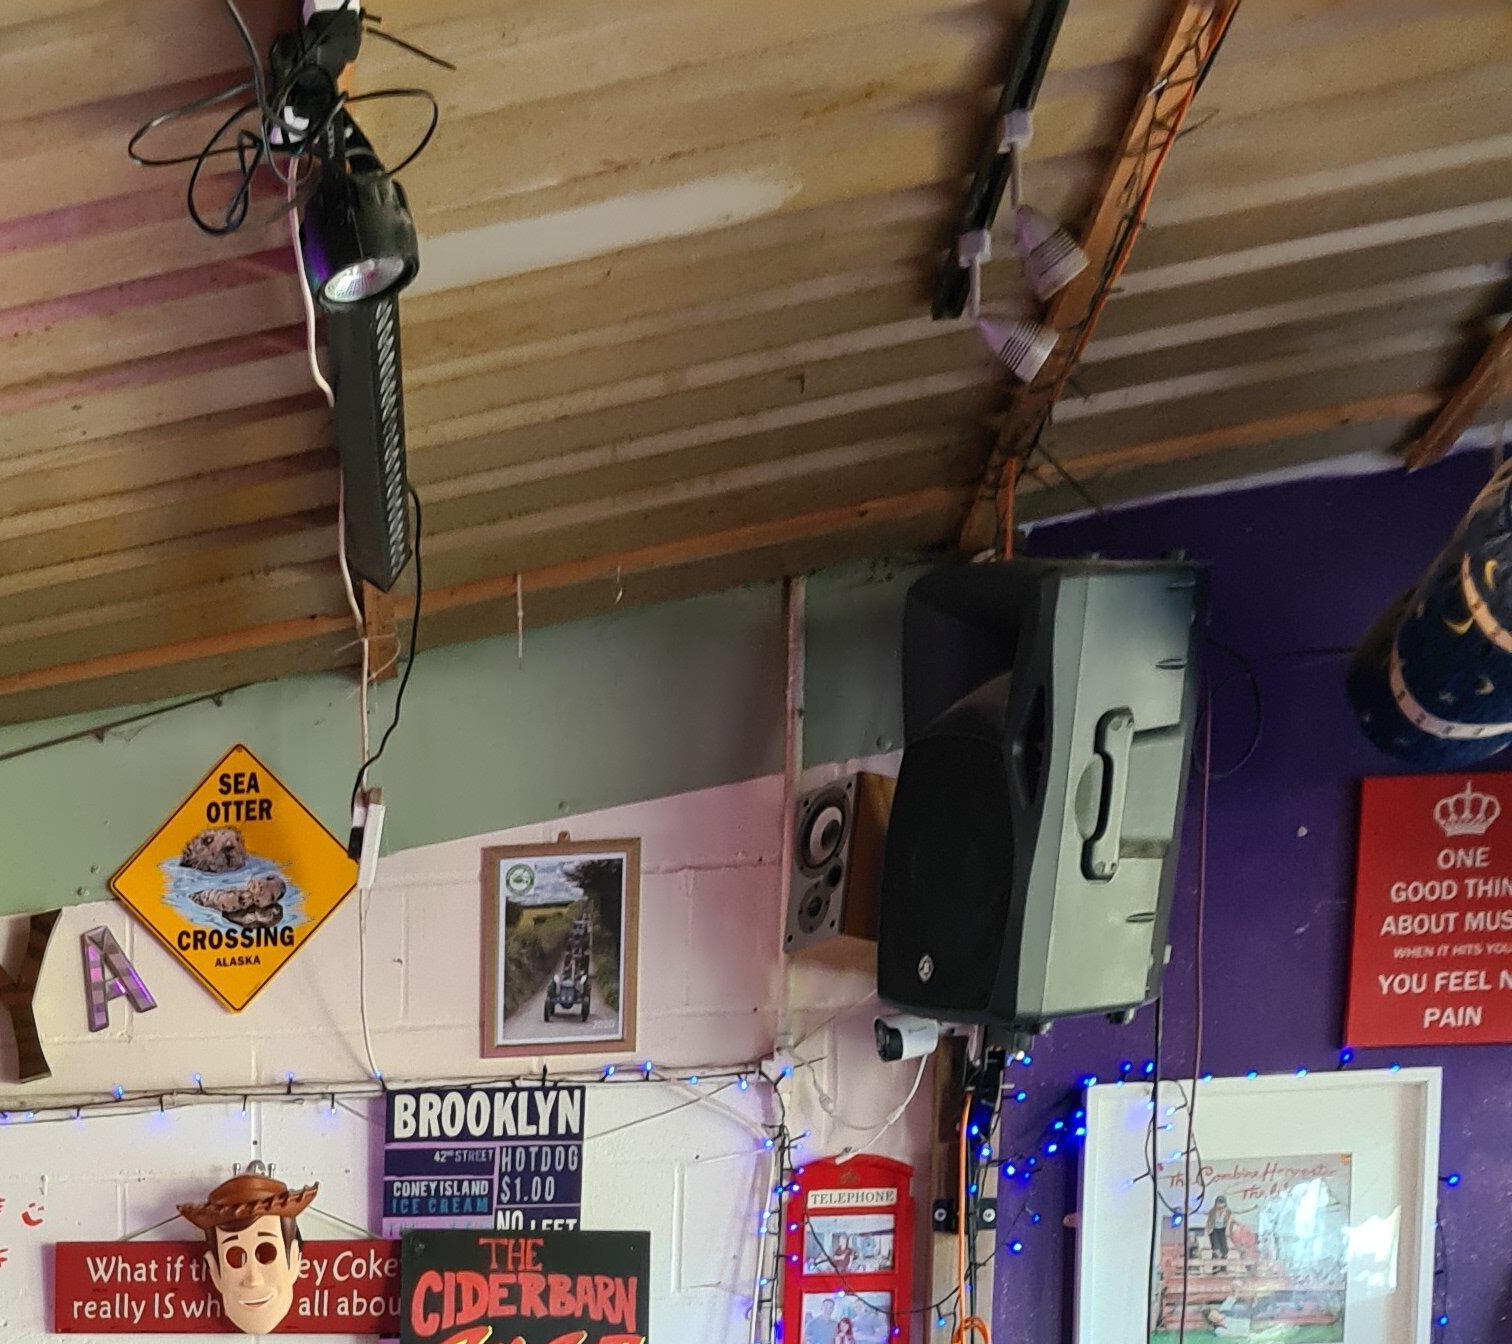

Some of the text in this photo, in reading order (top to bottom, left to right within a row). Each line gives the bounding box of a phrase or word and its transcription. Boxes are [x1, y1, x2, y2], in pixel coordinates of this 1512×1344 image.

[217, 771, 260, 796] SEA
[205, 798, 273, 824] OTTER
[1437, 846, 1491, 870] ONE
[1390, 880, 1458, 903] GOOD
[1380, 912, 1460, 938] ABOUT
[176, 925, 295, 952] CROSSING
[214, 954, 262, 968] ALASKA
[1377, 969, 1493, 996] YOU FEEL
[1423, 1005, 1483, 1030] PAIN
[393, 1088, 582, 1139] BROOKLYN
[454, 1149, 494, 1163] STREET
[500, 1145, 579, 1172] HOTDOG
[393, 1178, 489, 1197] CONEY ISLAND
[500, 1175, 556, 1204] $1.00
[809, 1190, 895, 1206] TELEPHONE
[391, 1196, 489, 1215] ICE CREAM
[478, 1237, 545, 1273] THE
[86, 1253, 159, 1284] What
[166, 1254, 186, 1284] if
[72, 1289, 329, 1325] really IS all
[410, 1269, 638, 1338] CIDERBARN
